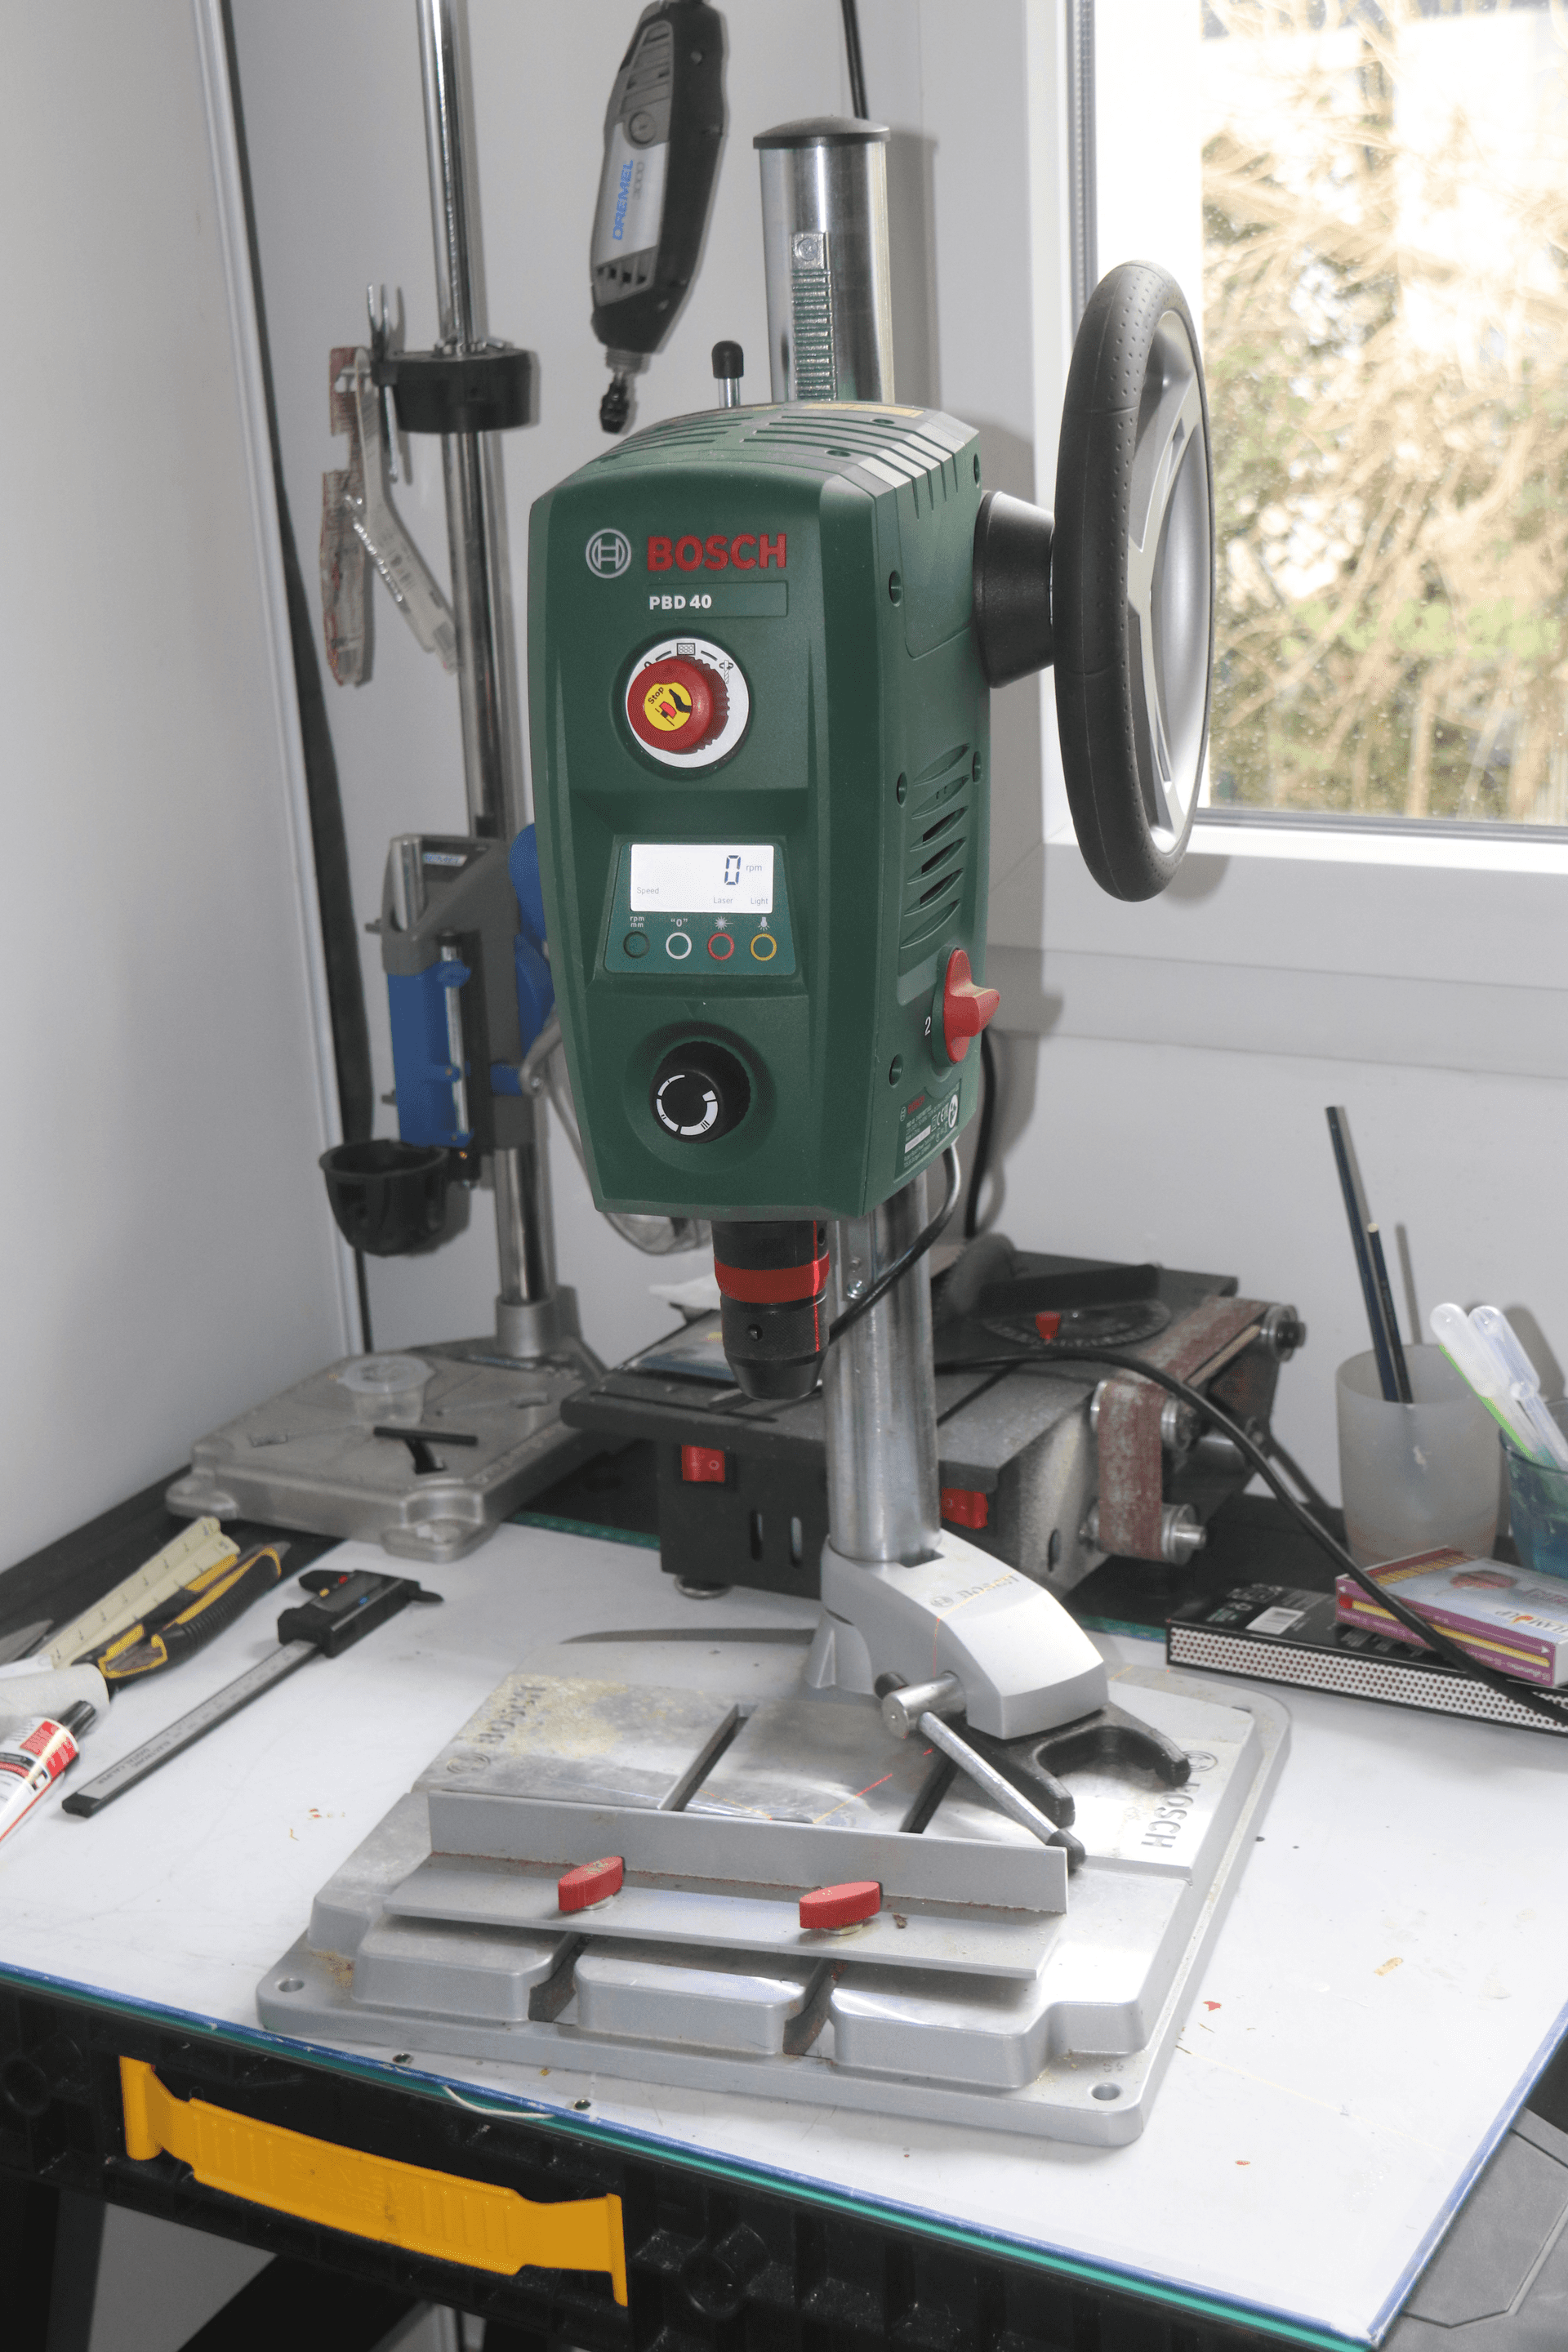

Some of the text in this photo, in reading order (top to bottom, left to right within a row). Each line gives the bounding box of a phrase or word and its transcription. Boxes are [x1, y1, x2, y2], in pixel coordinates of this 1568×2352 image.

[612, 160, 633, 240] DREMEL
[647, 533, 786, 572] BOSCH
[649, 595, 712, 610] PBD 40
[648, 686, 664, 705] Stop
[724, 855, 763, 885] 0 rpm
[636, 886, 659, 895] Speed
[713, 897, 768, 906] Laser Light
[924, 1016, 932, 1036] 2
